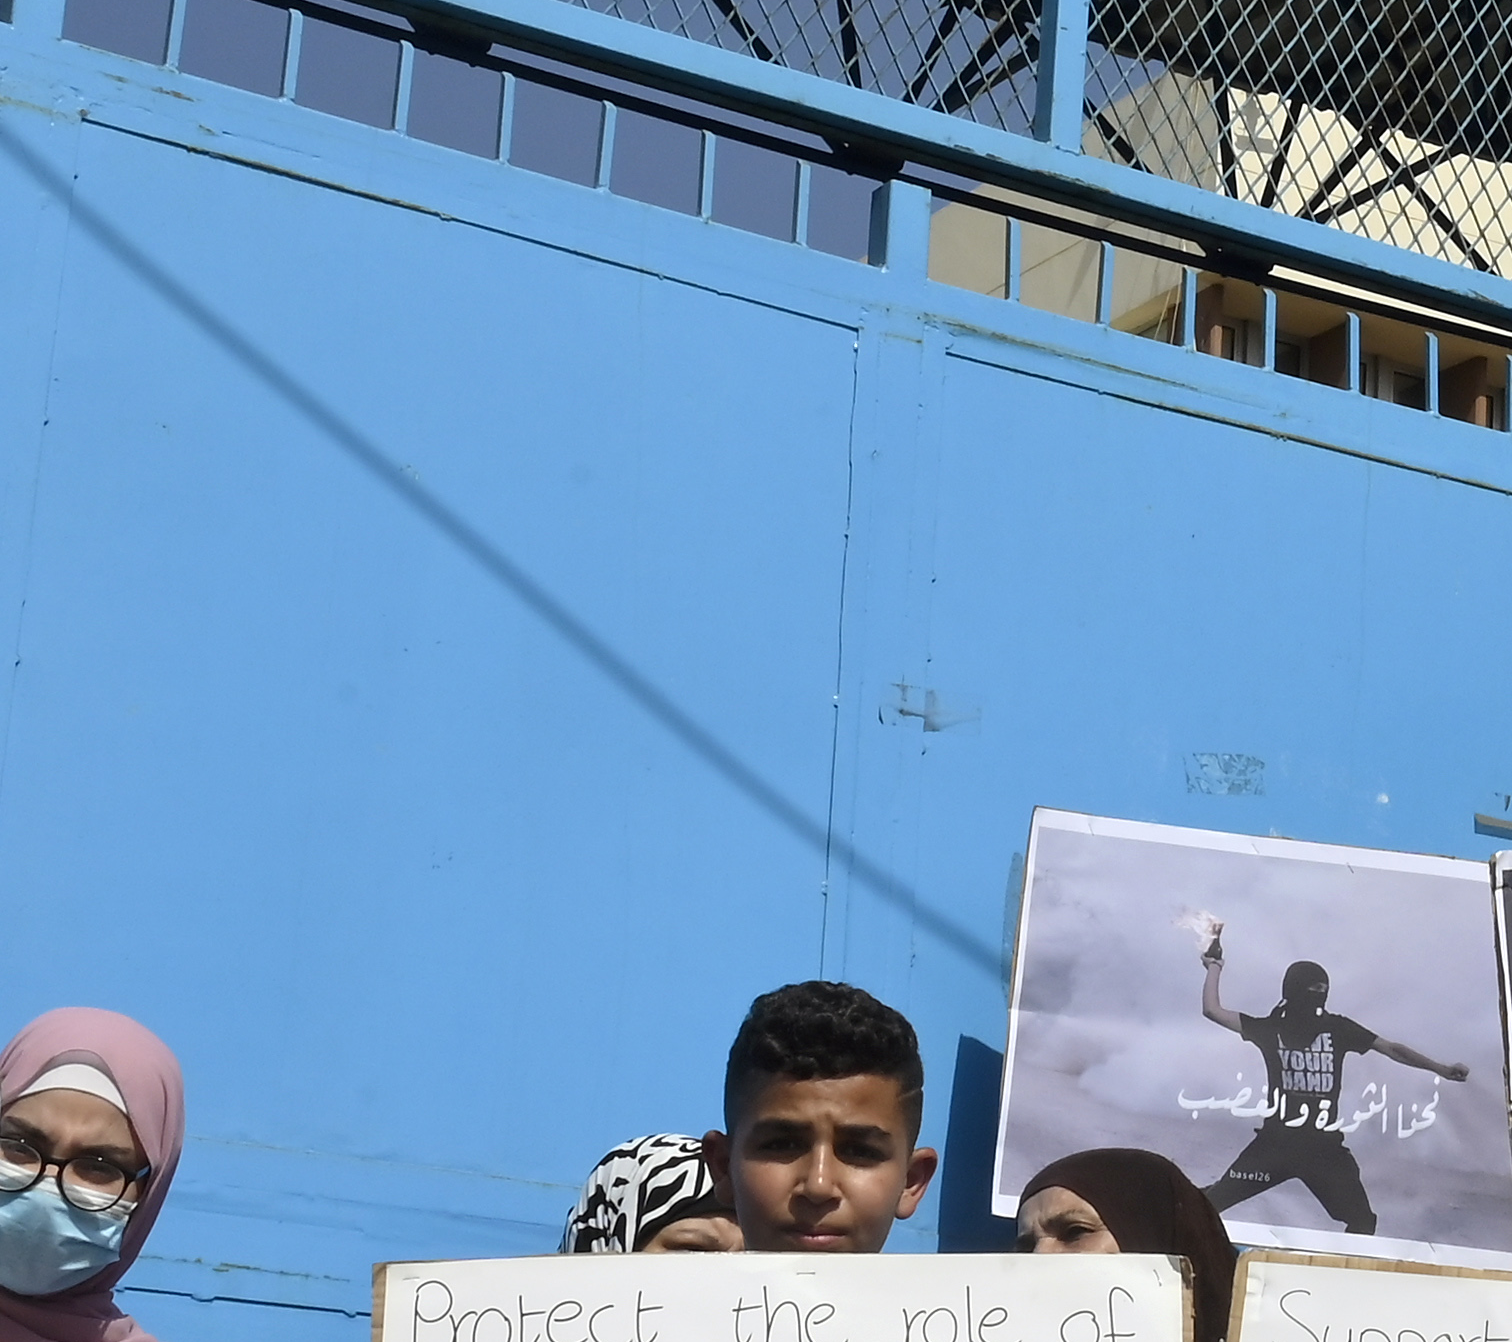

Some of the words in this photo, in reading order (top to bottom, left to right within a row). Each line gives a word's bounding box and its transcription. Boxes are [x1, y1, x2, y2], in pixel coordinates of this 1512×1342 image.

[1277, 1050, 1334, 1072] YOUR
[1282, 1070, 1334, 1092] HAND
[1315, 1082, 1388, 1134] الثورة
[1398, 1076, 1441, 1139] نحنا
[1229, 1169, 1271, 1182] basel26
